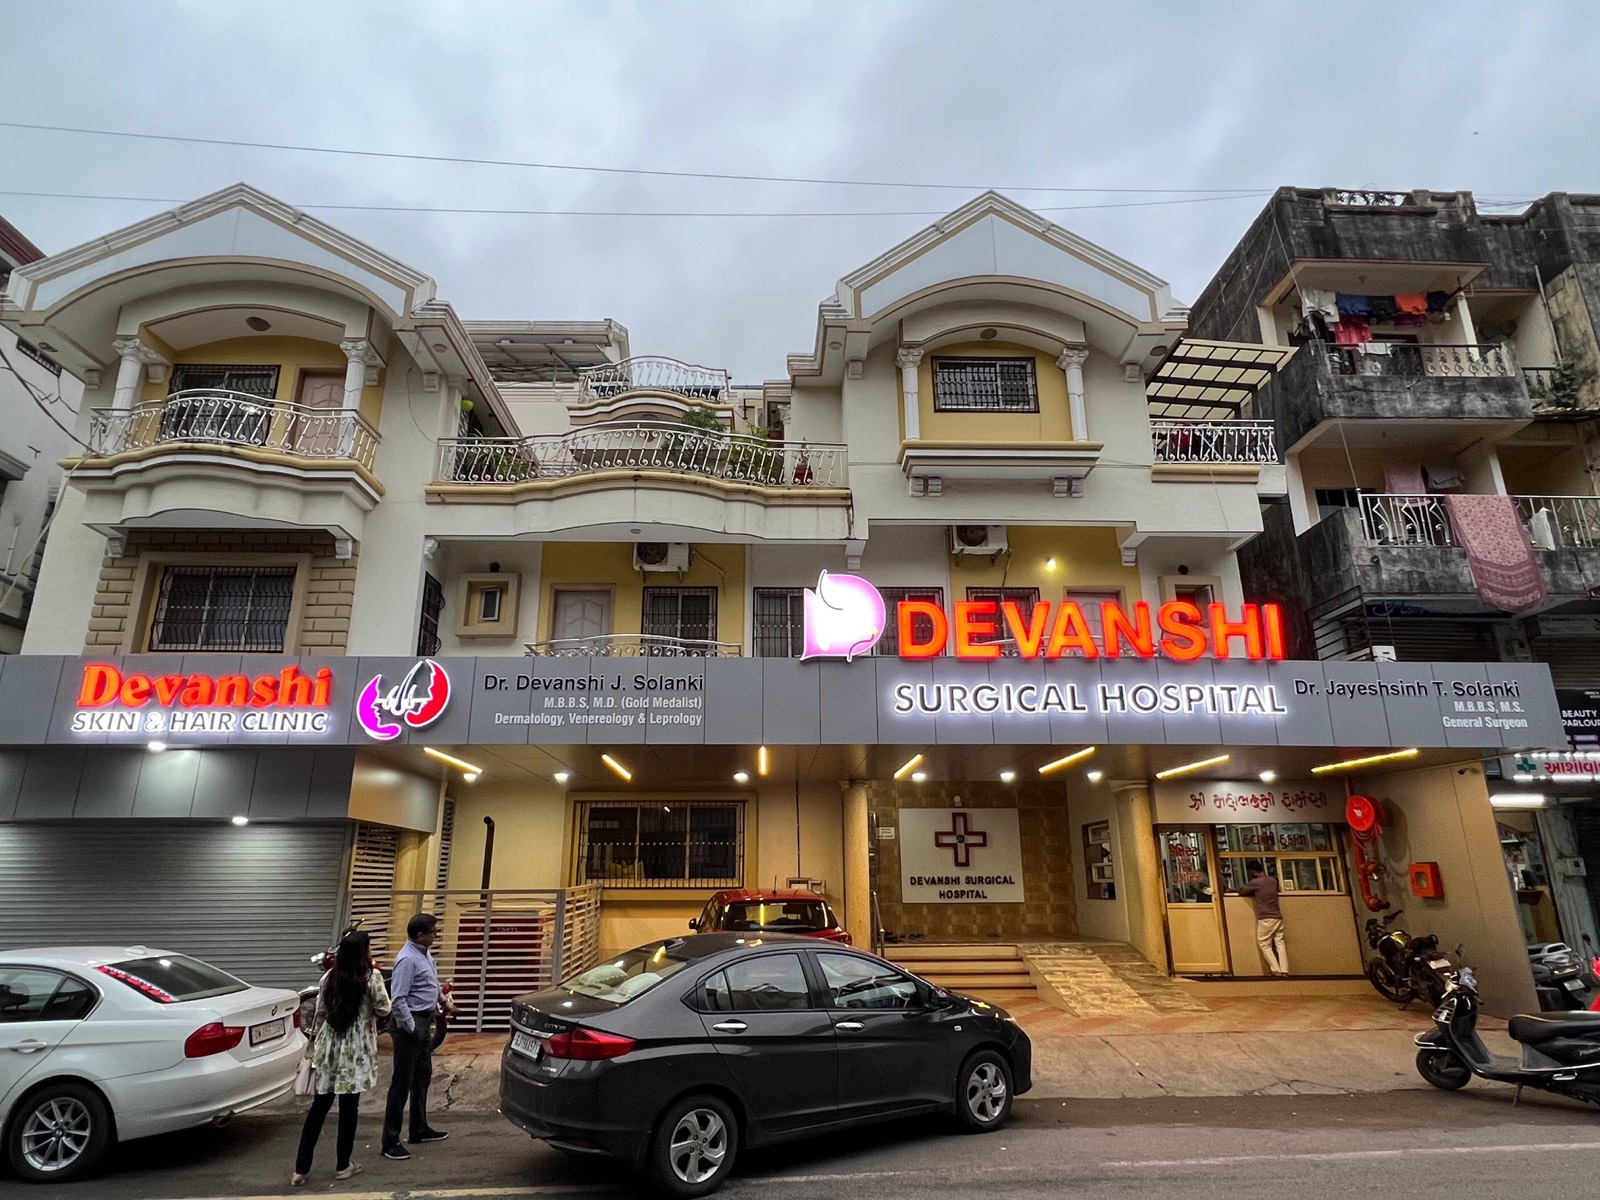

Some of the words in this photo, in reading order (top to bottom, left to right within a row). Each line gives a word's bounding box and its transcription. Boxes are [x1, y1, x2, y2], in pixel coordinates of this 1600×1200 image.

[898, 601, 1284, 660] DEVANSHI
[77, 664, 332, 707] Devanshi
[484, 674, 508, 691] Dr.
[516, 674, 605, 691] Devanshi
[611, 674, 626, 691] J.
[634, 674, 703, 691] Solanki
[1294, 679, 1319, 695] Dr.
[1325, 679, 1428, 698] Jayeshsinh
[1432, 681, 1447, 697] T.
[1452, 681, 1520, 697] Solanki
[593, 697, 617, 709] M.D.
[621, 696, 649, 709] (Gold
[653, 696, 702, 709] Medalist)
[895, 683, 1087, 714] SURGICAL
[1098, 684, 1288, 715] HOSPITAL
[1500, 701, 1524, 712] M.S.
[495, 713, 565, 727] Dermatology,
[569, 713, 634, 727] Venereology
[638, 714, 646, 724] &
[650, 713, 702, 727] Leprology
[1561, 709, 1598, 718] BEAUTY
[72, 712, 138, 732] SKIN
[145, 713, 164, 732] &
[170, 712, 236, 732] HAIR
[242, 712, 328, 733] CLINIC
[1443, 716, 1482, 728] General
[1486, 717, 1528, 730] Surgeon
[1189, 792, 1206, 811] શ્રી
[910, 876, 960, 885] DEVANSHI
[965, 876, 1015, 885] SURGICAL
[939, 890, 988, 899] HOSPITAL
